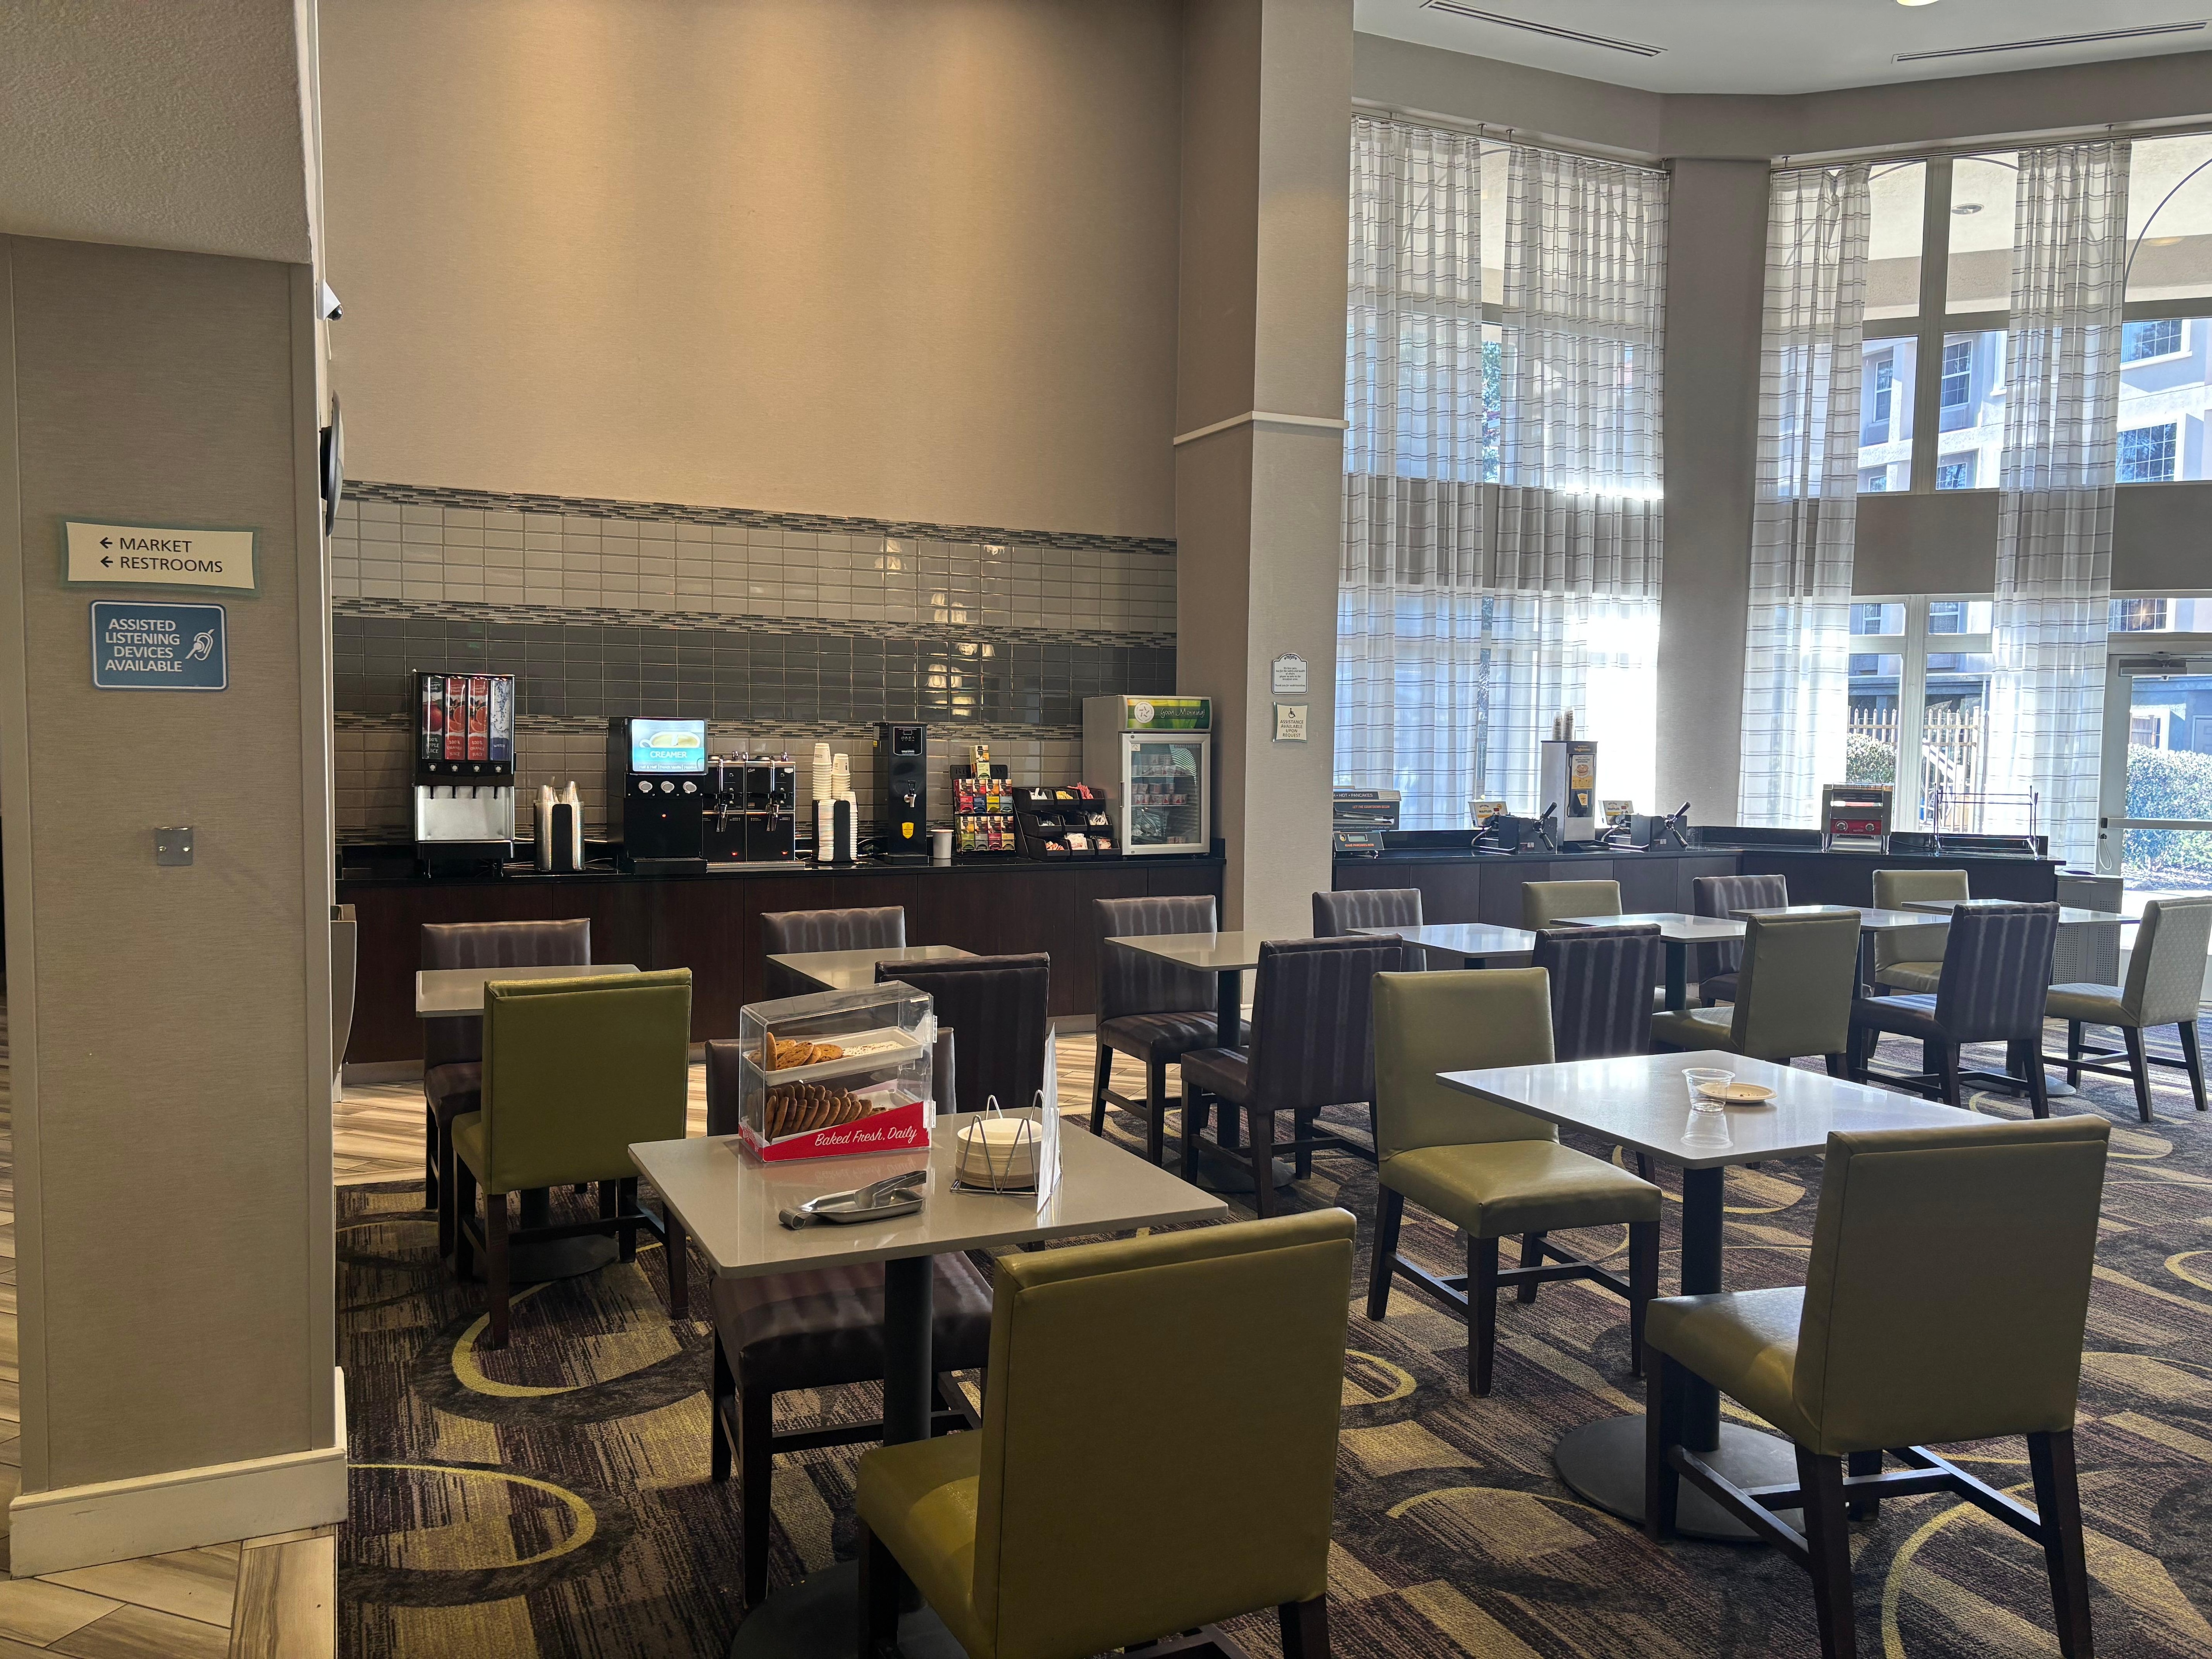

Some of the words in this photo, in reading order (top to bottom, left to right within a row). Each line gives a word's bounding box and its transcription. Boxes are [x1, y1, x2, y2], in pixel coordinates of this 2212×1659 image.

[120, 538, 192, 553] MARKET
[121, 557, 223, 572] RESTROOMS
[108, 618, 176, 631] ASSISTED
[105, 632, 180, 645] LISTENING
[114, 646, 173, 658] DEVICES
[105, 661, 182, 672] AVAILABLE
[1160, 708, 1174, 718] Good
[1176, 707, 1205, 718] Morning!
[815, 1131, 852, 1146] Baked
[887, 1125, 918, 1144] Daily
